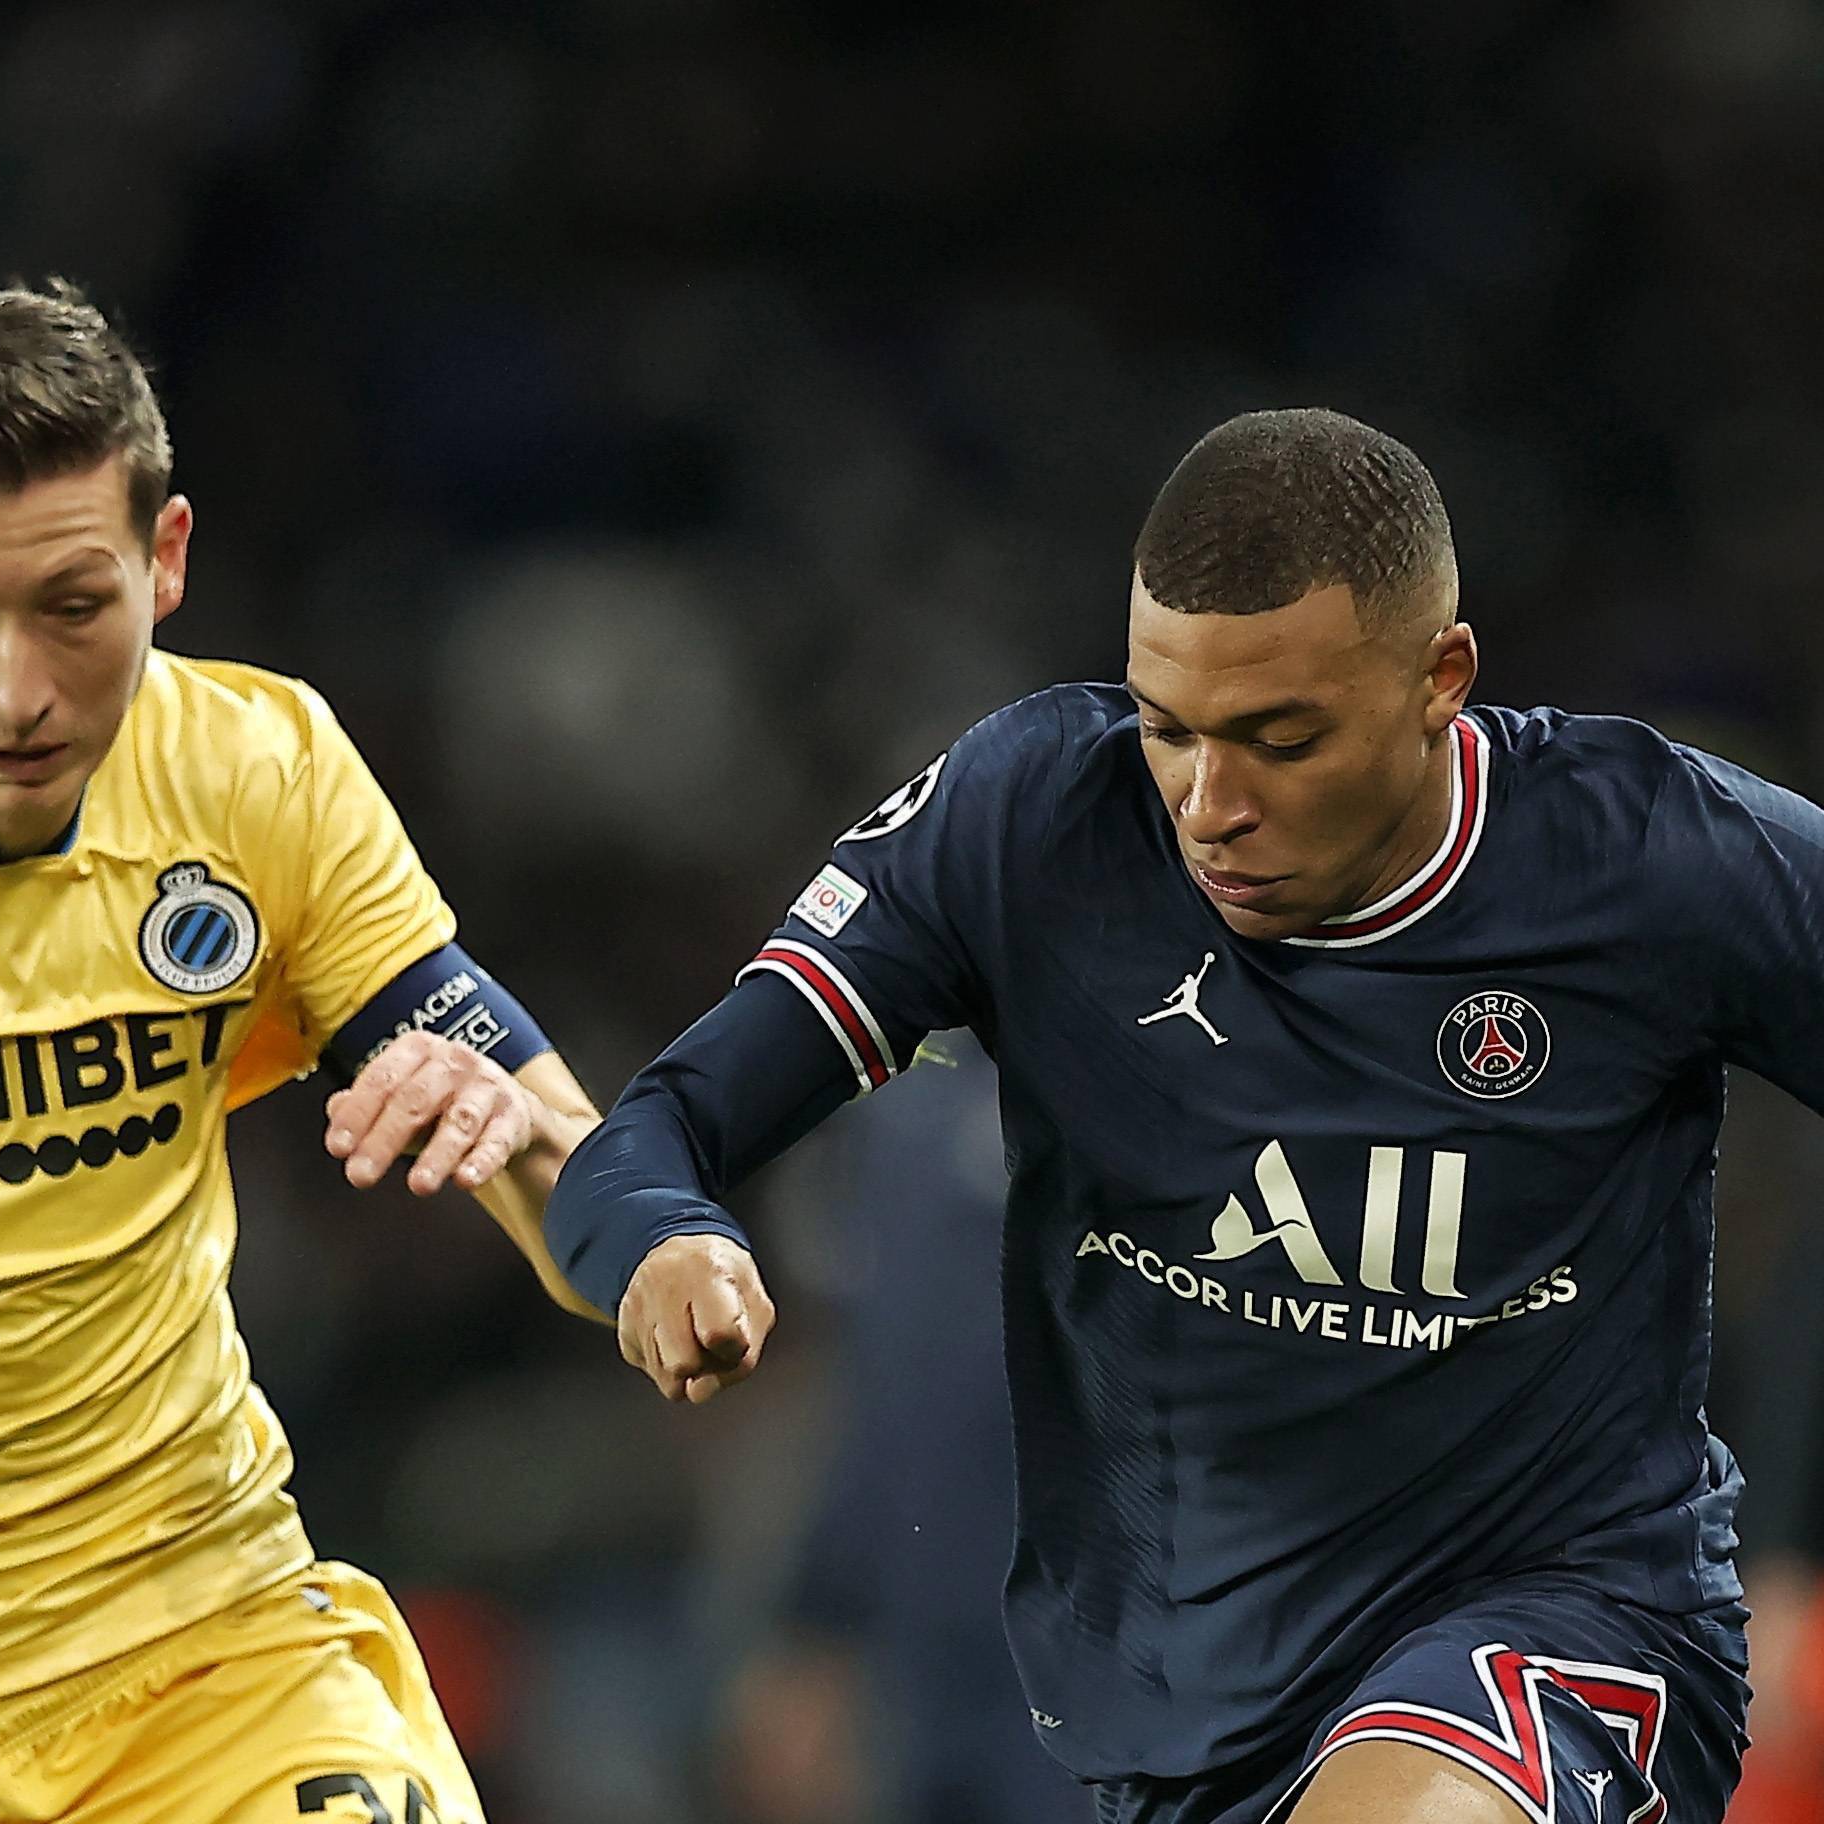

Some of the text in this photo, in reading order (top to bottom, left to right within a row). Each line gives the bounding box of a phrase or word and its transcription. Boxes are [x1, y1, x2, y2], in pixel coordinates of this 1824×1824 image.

[1452, 996, 1526, 1027] PARIS
[1075, 1231, 1232, 1313] ACCOR
[1244, 1291, 1349, 1341] LIVE
